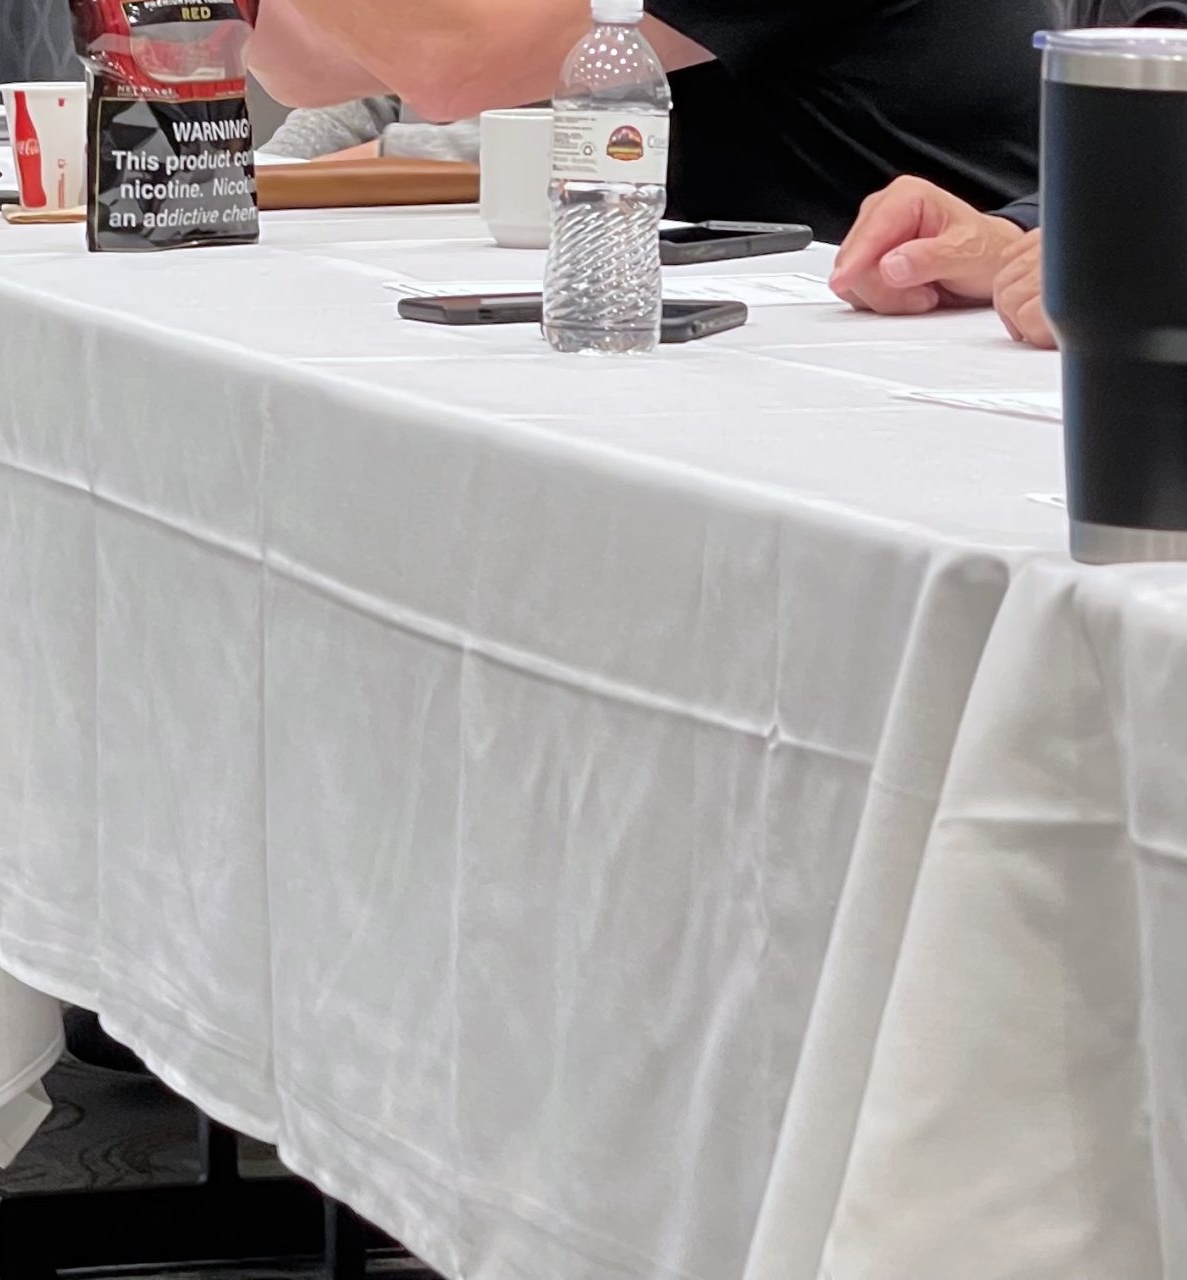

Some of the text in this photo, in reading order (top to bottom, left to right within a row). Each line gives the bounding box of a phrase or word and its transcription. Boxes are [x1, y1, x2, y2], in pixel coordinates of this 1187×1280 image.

[181, 6, 211, 20] RED
[112, 149, 159, 170] This
[166, 149, 230, 176] product
[120, 179, 204, 199] nicotine.
[109, 211, 136, 228] an
[143, 207, 219, 228] addictive
